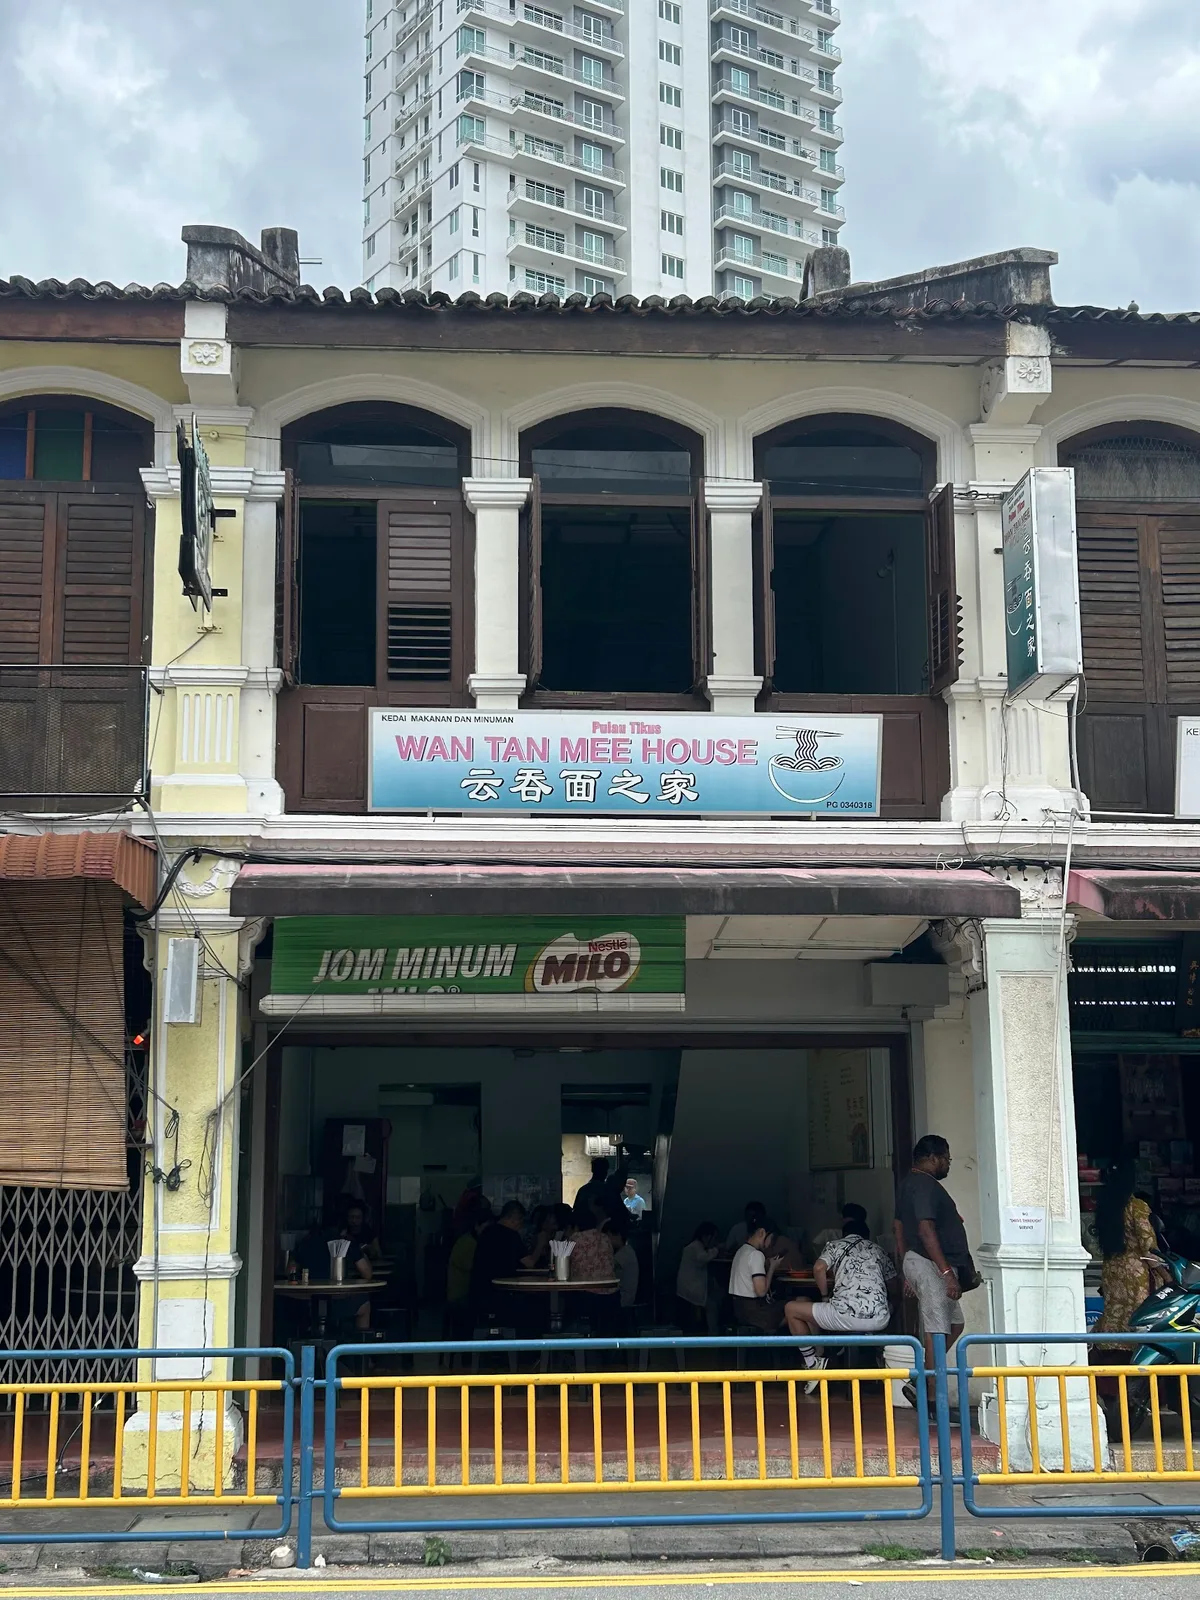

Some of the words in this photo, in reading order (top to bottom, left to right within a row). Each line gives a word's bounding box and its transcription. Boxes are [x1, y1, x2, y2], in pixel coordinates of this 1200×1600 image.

[381, 714, 407, 722] KEDAI
[410, 715, 453, 723] MAKANAN
[473, 716, 514, 724] MINUMAN
[592, 721, 626, 734] Pulau
[629, 721, 661, 735] Tikus
[395, 735, 475, 762] WAN
[484, 736, 549, 763] TAN
[560, 737, 632, 764] MEE
[641, 738, 758, 766] HOUSE
[460, 768, 699, 804] 云吞面之家
[826, 801, 838, 809] PG
[840, 801, 873, 809] 0340318
[312, 948, 387, 983] JOM
[391, 943, 519, 980] MINUM
[541, 950, 632, 986] MILO
